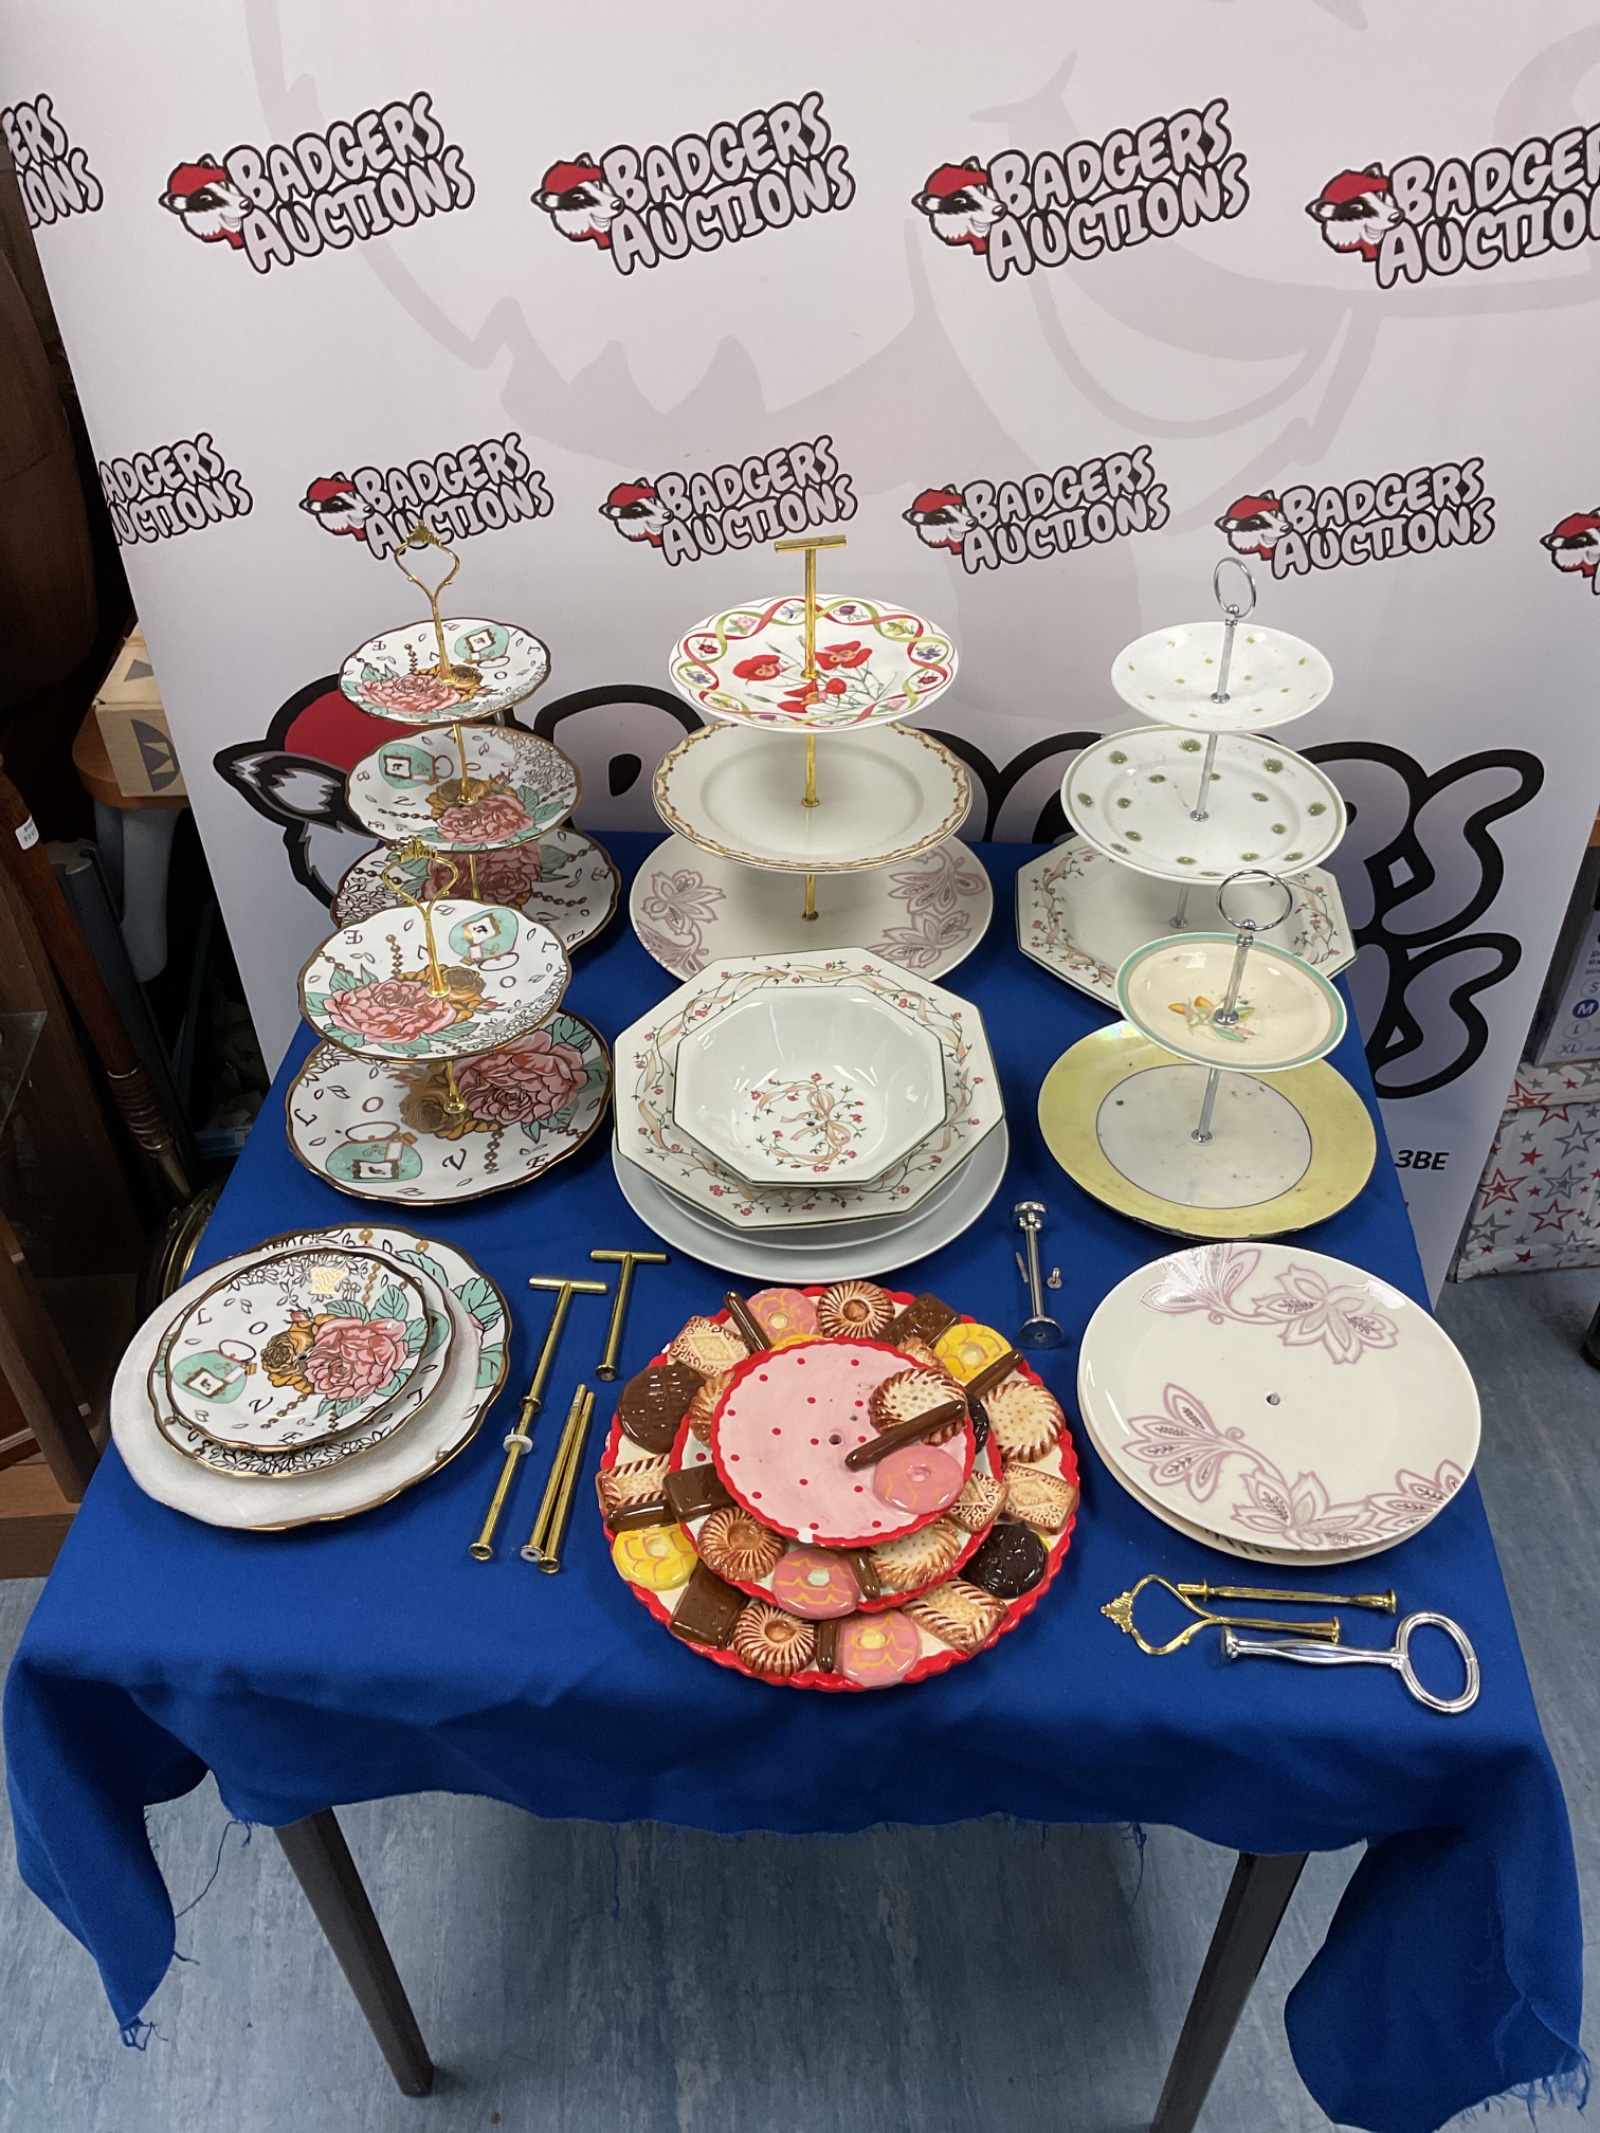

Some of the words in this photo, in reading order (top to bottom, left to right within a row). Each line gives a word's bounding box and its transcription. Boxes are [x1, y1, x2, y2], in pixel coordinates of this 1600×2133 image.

[223, 91, 444, 213] BADGERS
[600, 91, 831, 212] BADGERS
[987, 97, 1232, 219] BADGERS
[243, 145, 475, 274] AUCTIONS
[611, 145, 856, 275] AUCTIONS
[986, 152, 1250, 282] AUCTIONS
[1375, 183, 1600, 289] AUCTIO
[107, 470, 253, 546] UCTIONS
[352, 432, 530, 515] BADGERS
[654, 435, 838, 522] BADGERS
[962, 444, 1155, 529] BADGERS
[1280, 457, 1484, 535] BADGERS
[662, 474, 858, 566] AUCTIONS
[962, 484, 1170, 574] AUCTIONS
[1271, 497, 1495, 580] AUCTIONS
[1394, 1149, 1450, 1170] 3BE
